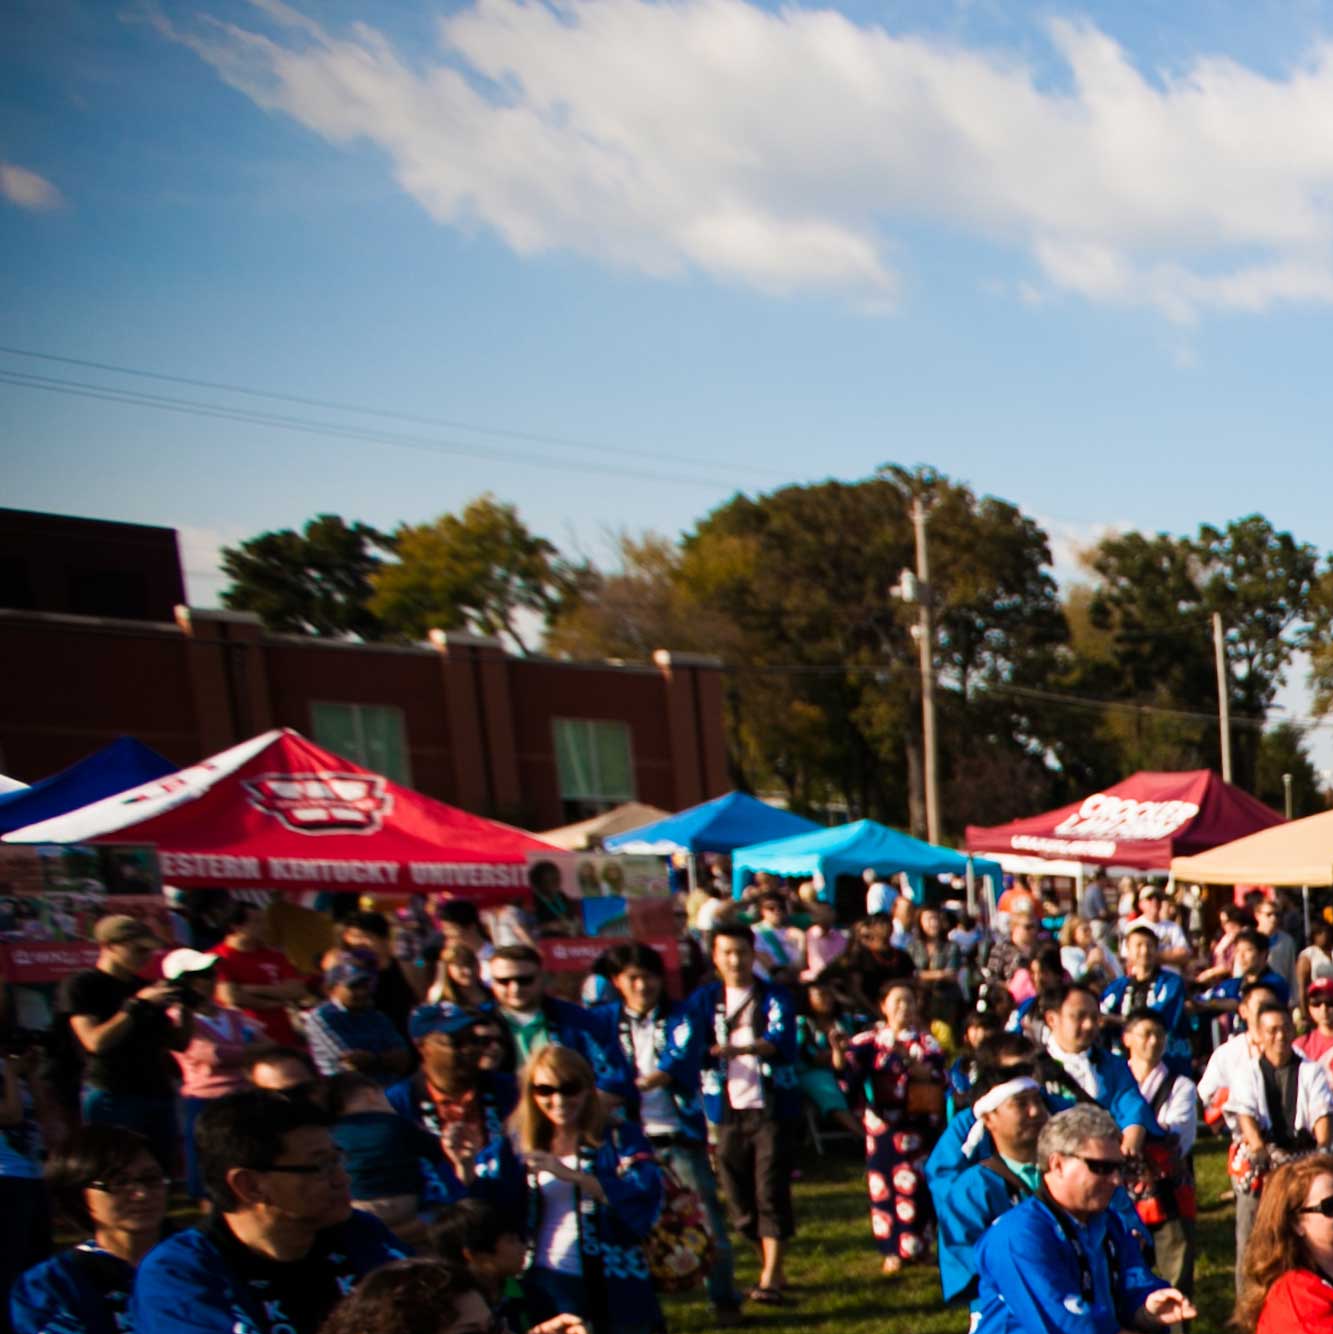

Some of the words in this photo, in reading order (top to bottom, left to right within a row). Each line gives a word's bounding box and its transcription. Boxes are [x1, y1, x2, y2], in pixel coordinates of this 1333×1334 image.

[160, 853, 260, 881] ESTERN
[268, 858, 400, 884] KENTUCKY
[408, 862, 528, 887] UNIVERSIT
